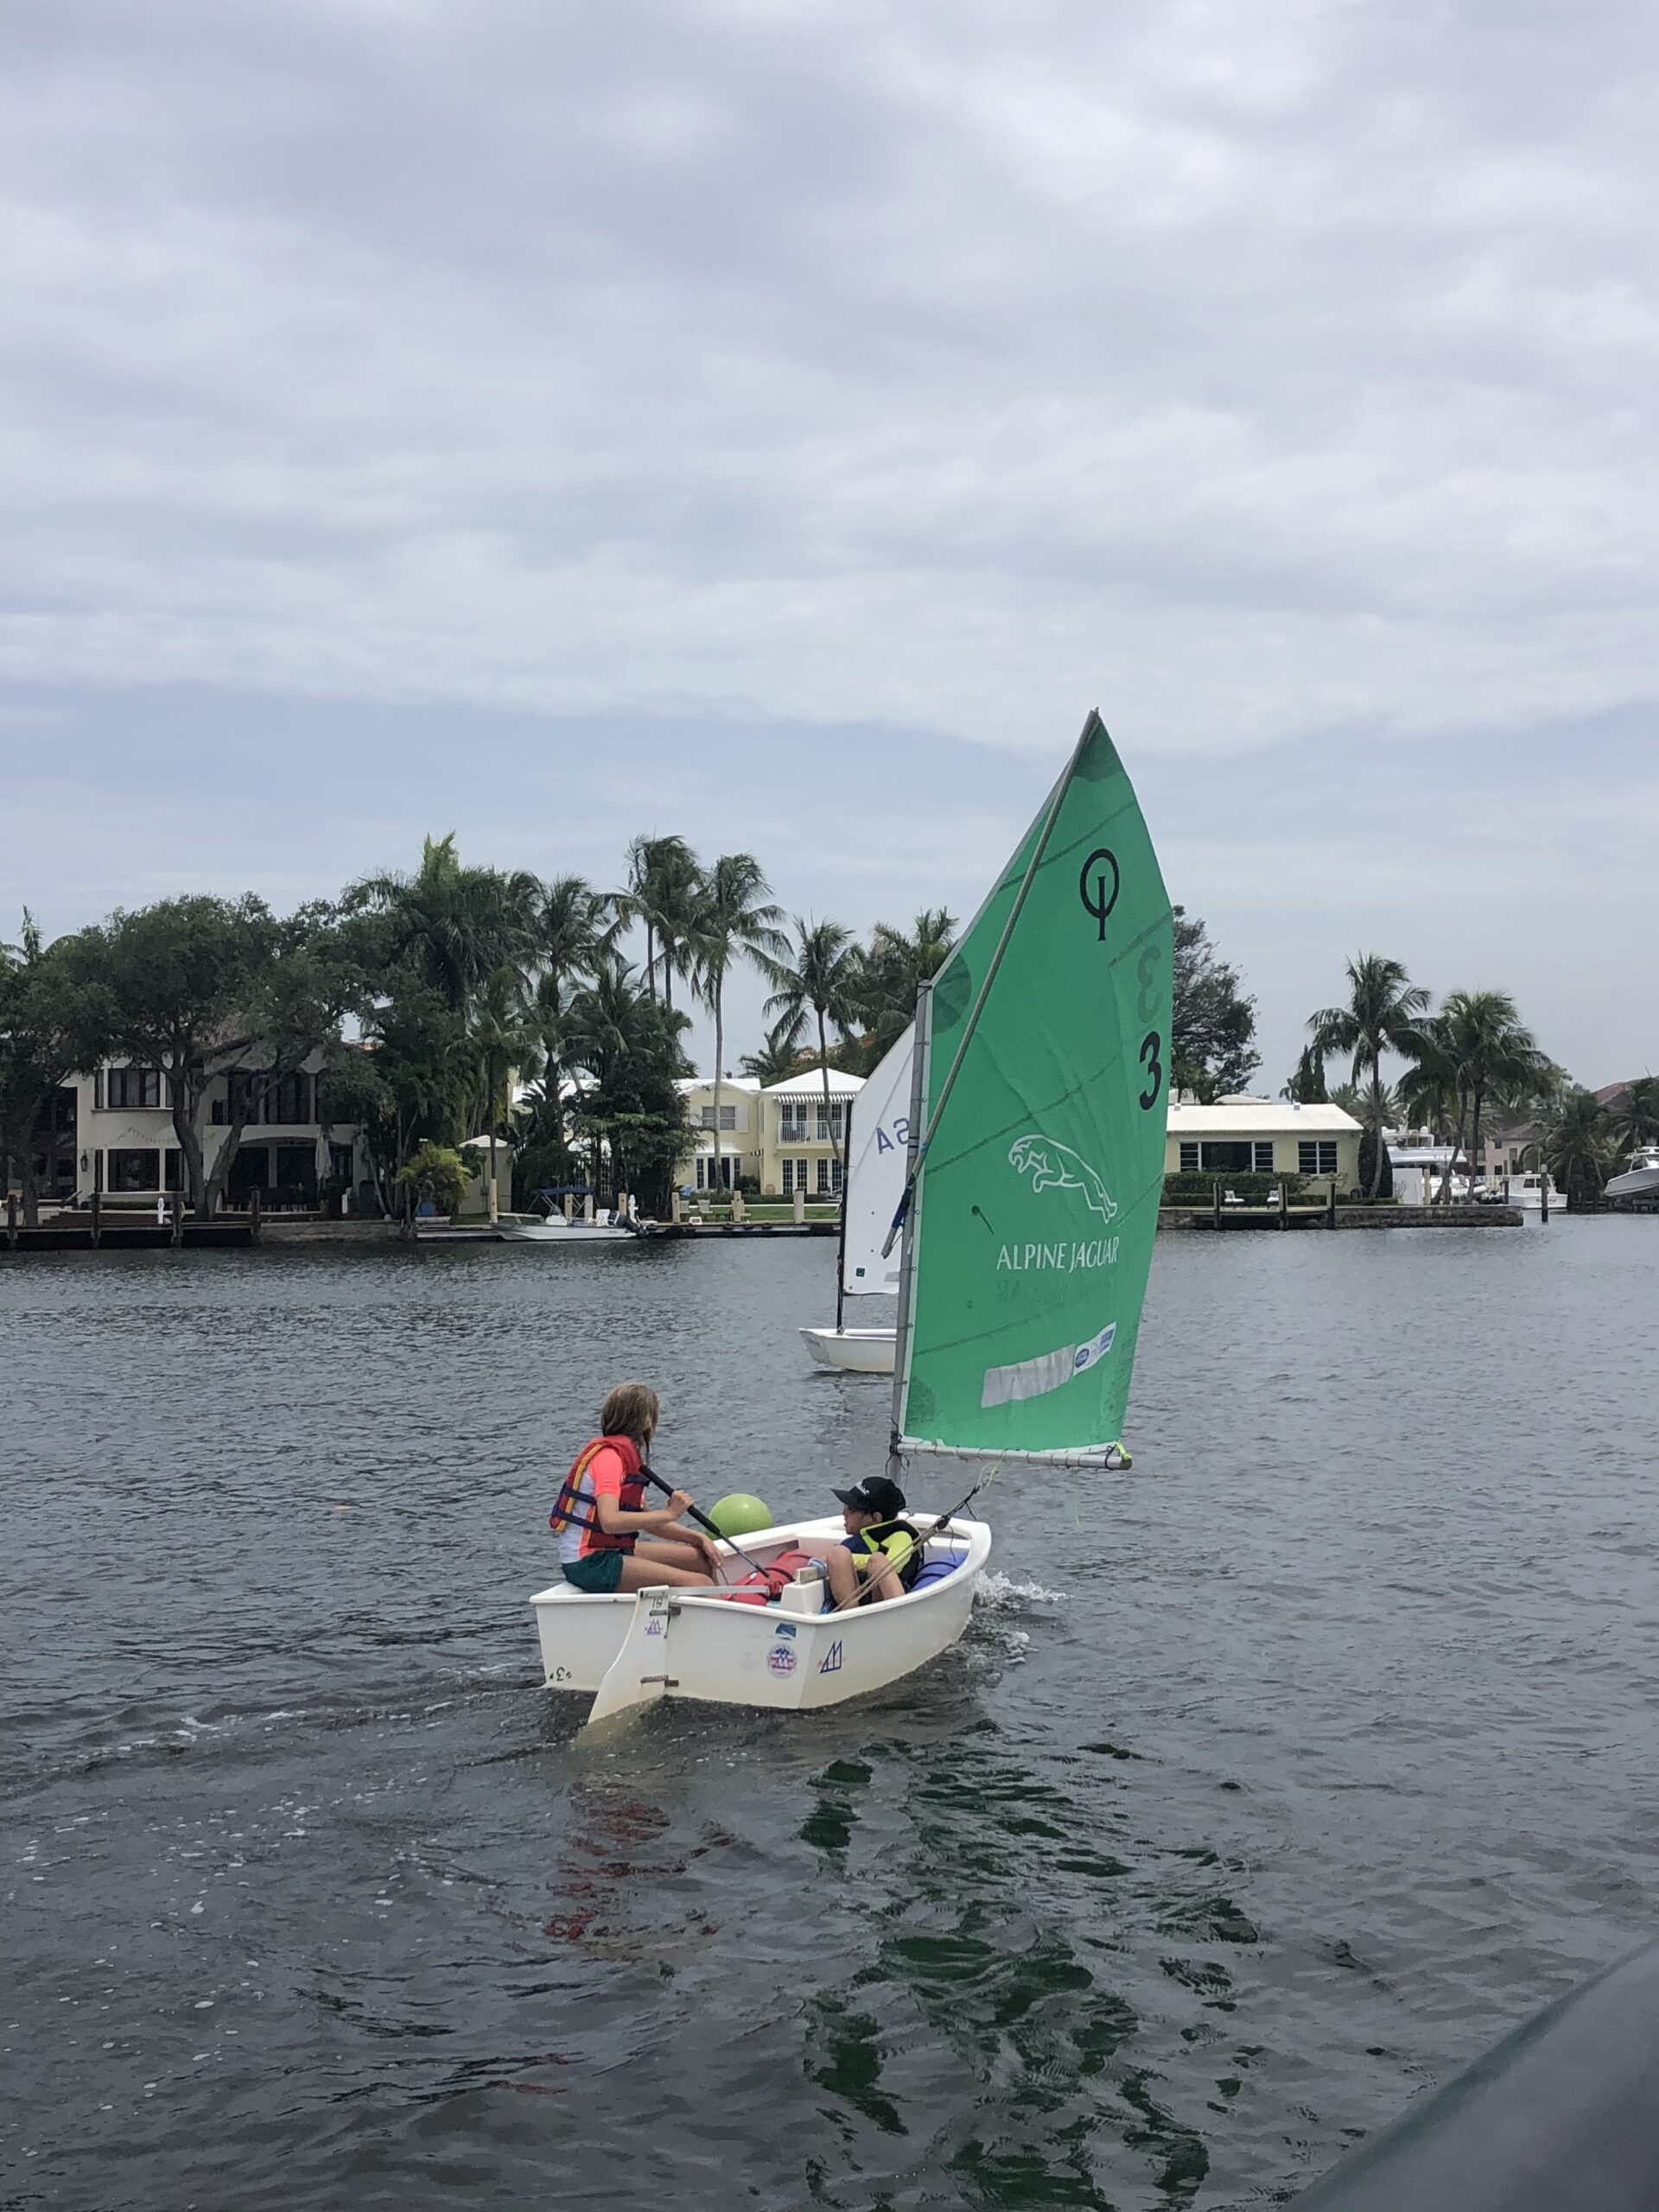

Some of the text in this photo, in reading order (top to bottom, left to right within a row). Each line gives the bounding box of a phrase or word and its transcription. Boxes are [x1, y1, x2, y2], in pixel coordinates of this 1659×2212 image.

[1139, 1031, 1162, 1110] 3
[996, 1236, 1120, 1273] ALPINE JAGUAR
